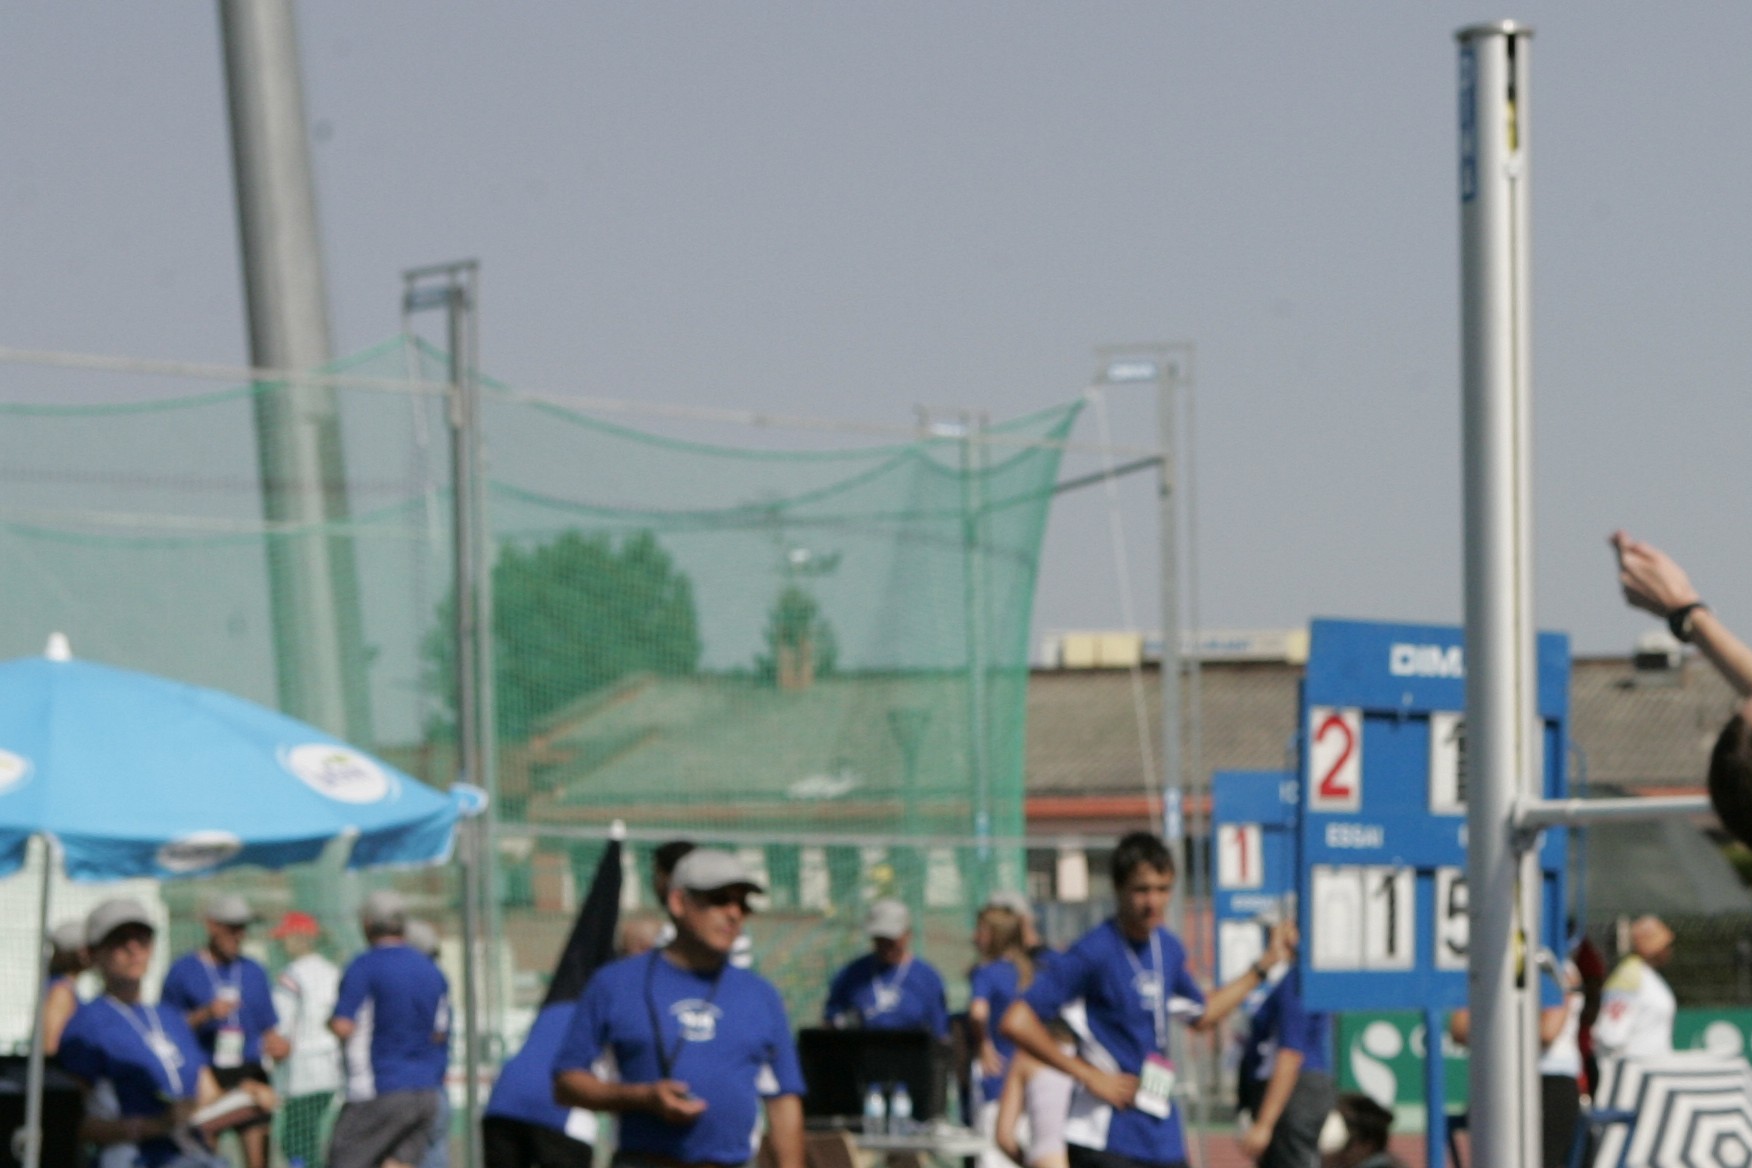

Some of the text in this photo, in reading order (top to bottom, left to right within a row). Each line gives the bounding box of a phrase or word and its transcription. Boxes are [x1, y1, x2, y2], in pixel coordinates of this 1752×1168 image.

[1391, 643, 1466, 678] DIM
[1313, 714, 1355, 799] 2
[1233, 826, 1248, 881] 1
[1374, 873, 1469, 957] 1 5
